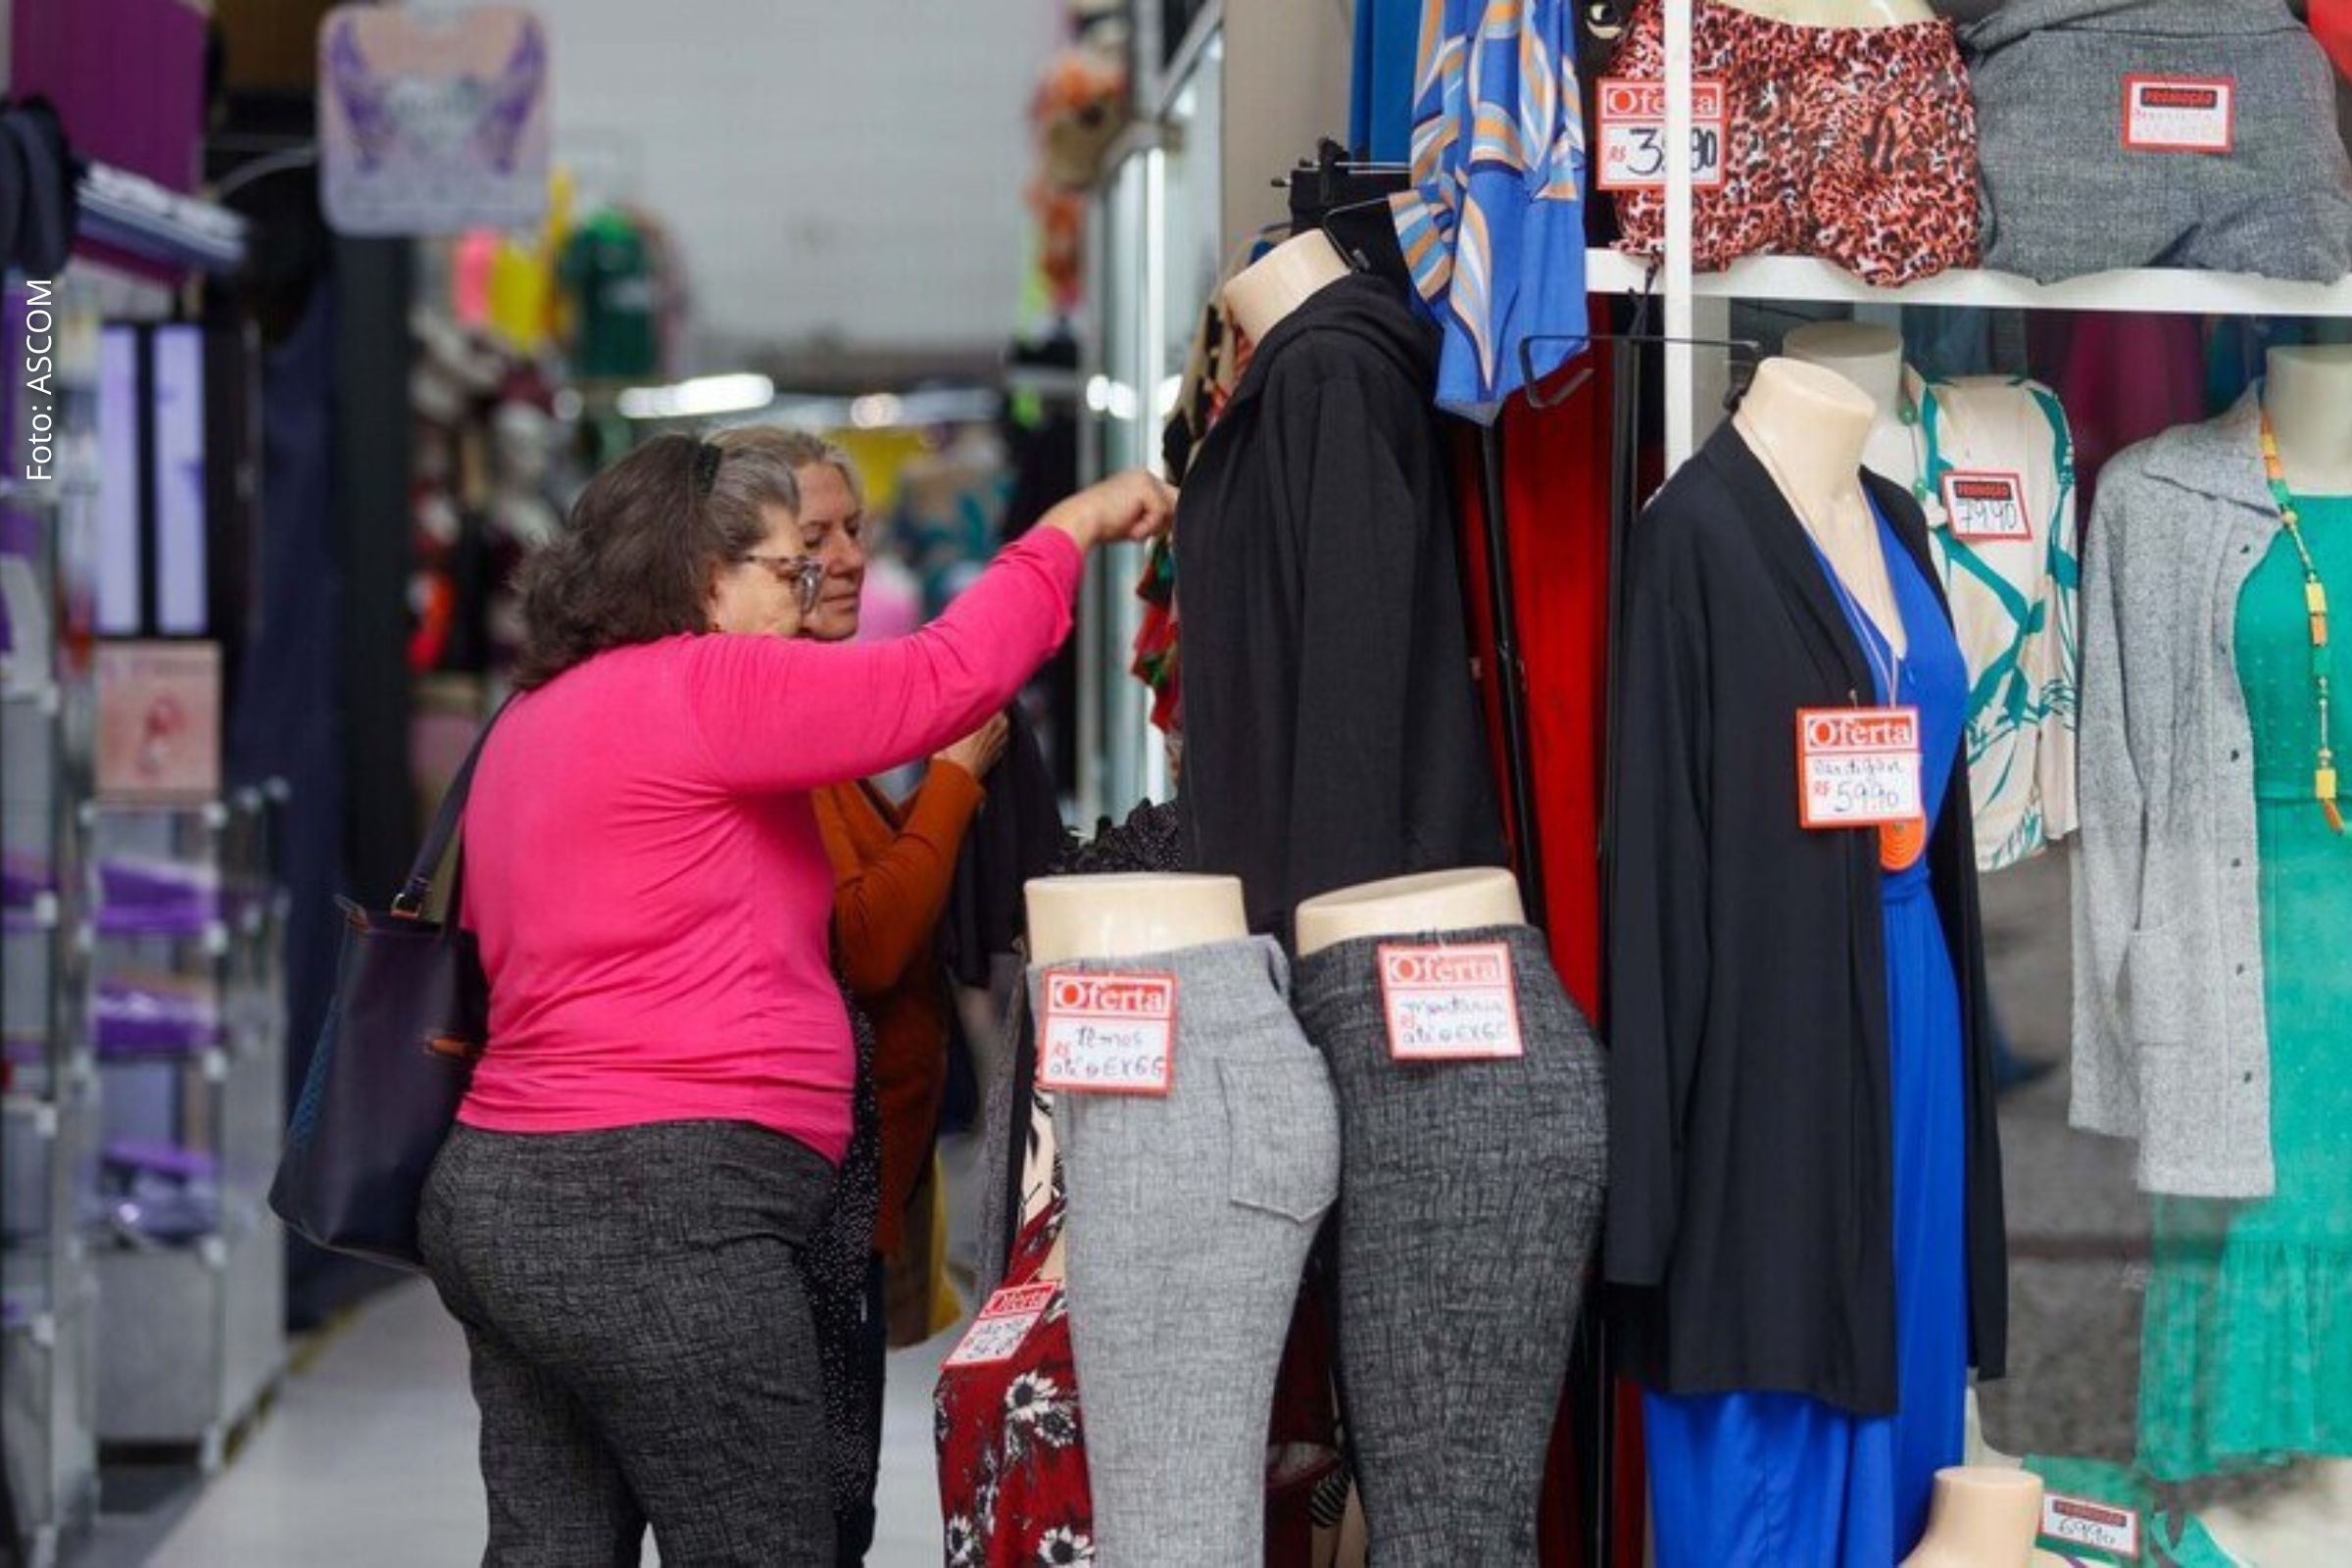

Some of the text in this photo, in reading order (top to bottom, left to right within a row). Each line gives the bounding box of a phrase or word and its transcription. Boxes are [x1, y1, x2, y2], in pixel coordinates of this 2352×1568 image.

[1607, 88, 1715, 116] Ofea
[1809, 718, 1910, 746] Oferta
[1395, 954, 1500, 982] Oferta
[1054, 981, 1163, 1011] Oferta
